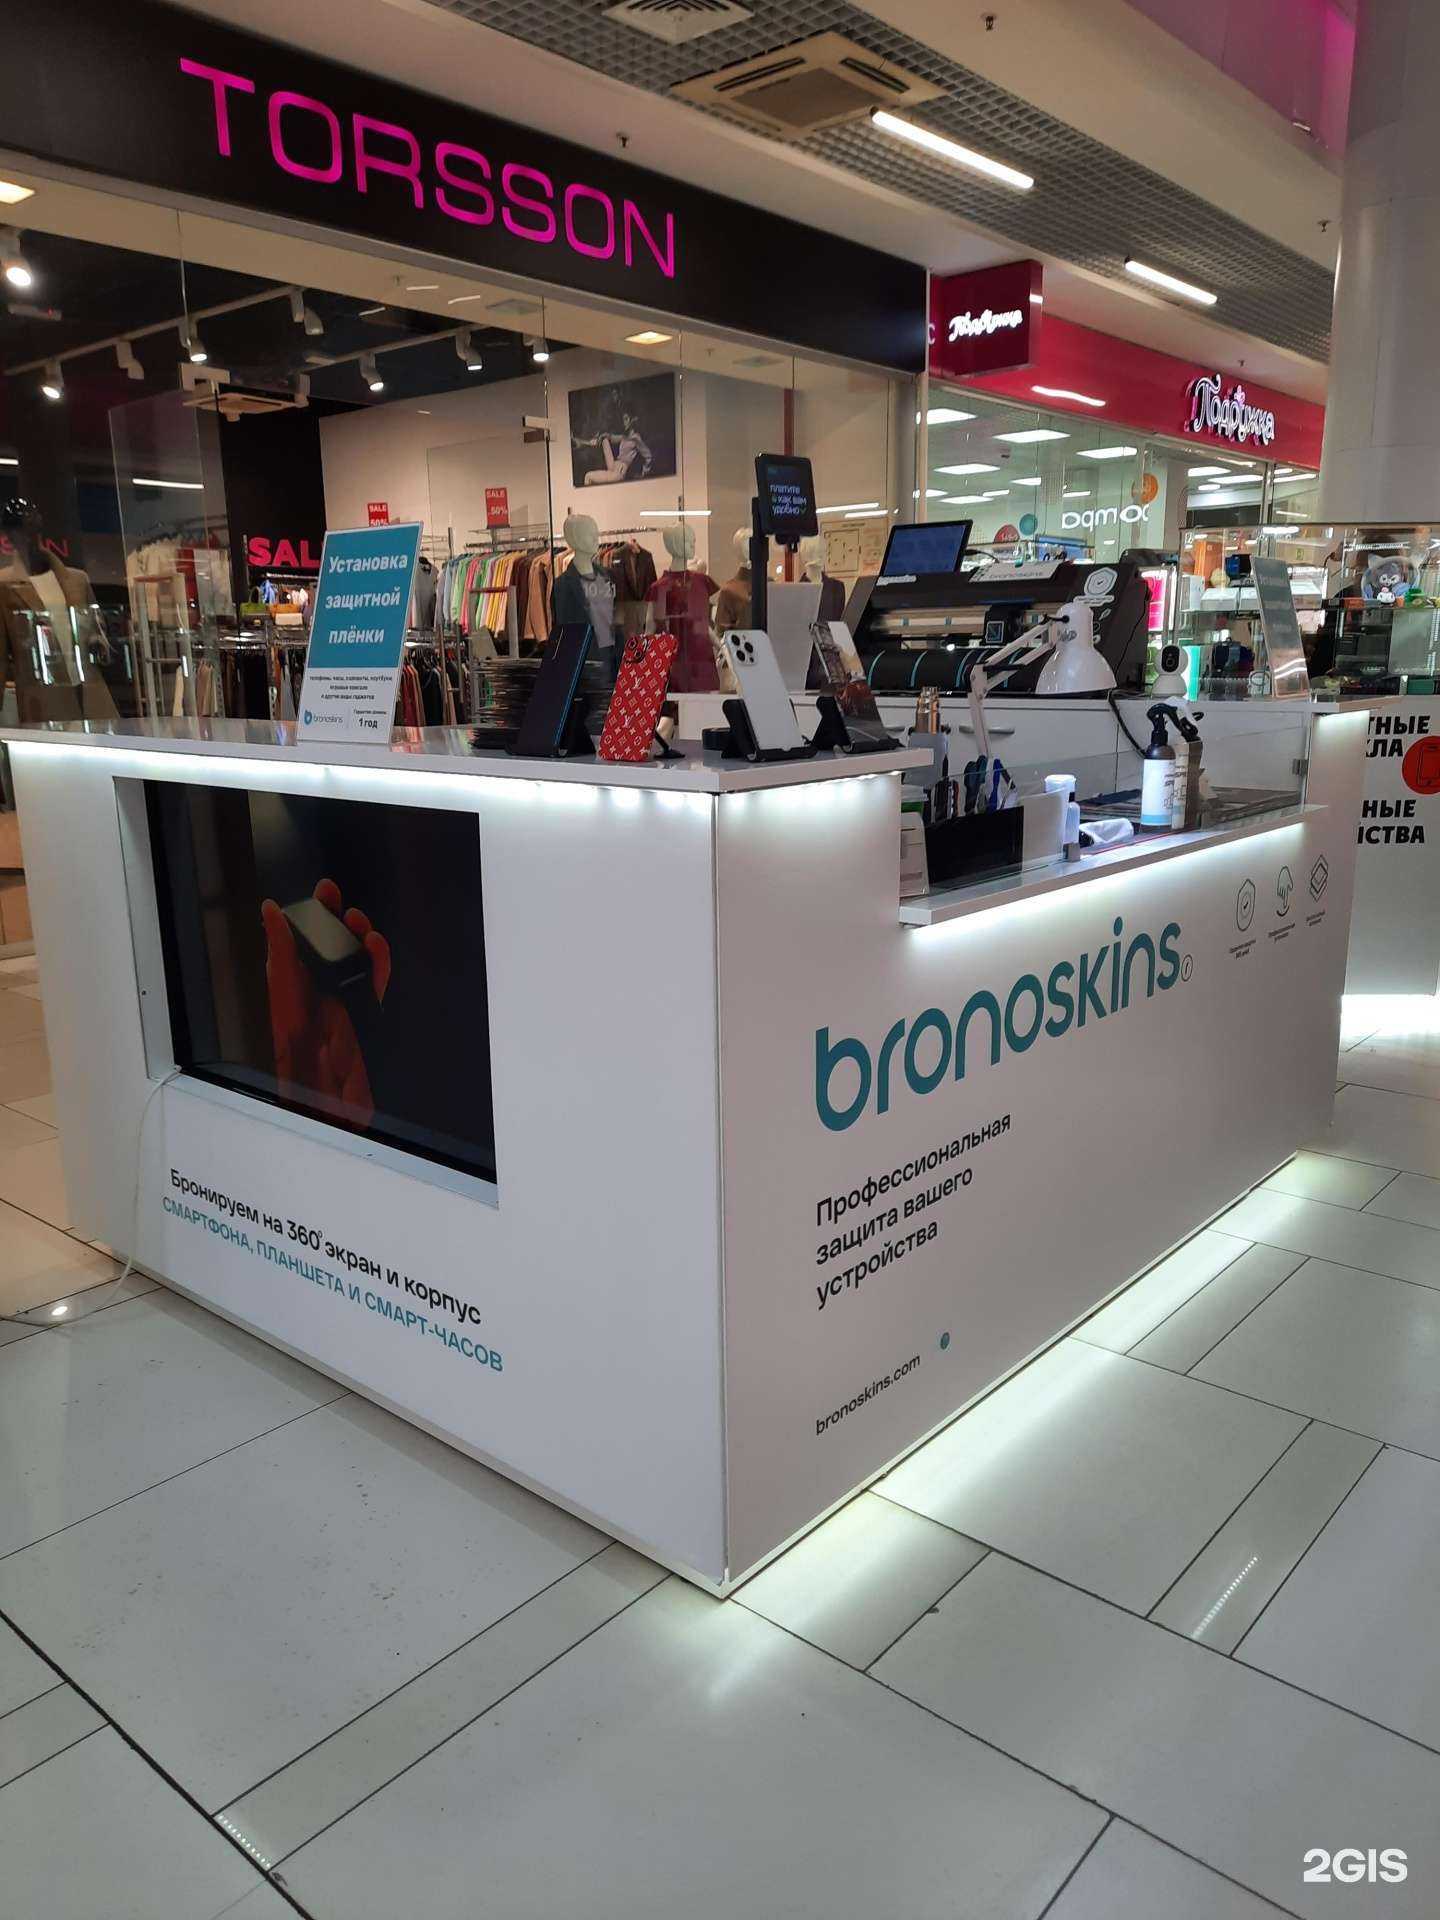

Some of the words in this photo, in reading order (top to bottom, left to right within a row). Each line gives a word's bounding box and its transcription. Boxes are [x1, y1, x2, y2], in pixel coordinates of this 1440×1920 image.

[180, 57, 676, 279] TORSSON
[1190, 373, 1276, 446] Подружка
[369, 504, 387, 513] SALE
[486, 490, 505, 498] SALE
[325, 586, 401, 611] защитной
[328, 554, 408, 573] Установка
[328, 626, 385, 645] плёнки
[358, 717, 363, 727] 1
[364, 719, 378, 729] год
[1361, 799, 1417, 819] НЫЕ
[815, 916, 1182, 1132] bronoskins
[816, 1113, 1011, 1227] Профессиональная
[170, 1168, 259, 1224] Бронируем
[263, 1215, 284, 1235] на
[325, 1240, 381, 1280] экран
[386, 1268, 399, 1289] и
[404, 1275, 482, 1326] корпус
[816, 1207, 899, 1266] защита
[903, 1167, 973, 1219] вашего
[162, 1196, 254, 1255] СМАРТФОНА,
[256, 1240, 346, 1297] ПЛАНШЕТА
[349, 1283, 361, 1304] И
[364, 1292, 504, 1373] СМАРТ-ЧАСОВ
[816, 1221, 939, 1311] устройства
[815, 1354, 921, 1436] bronoskins.com
